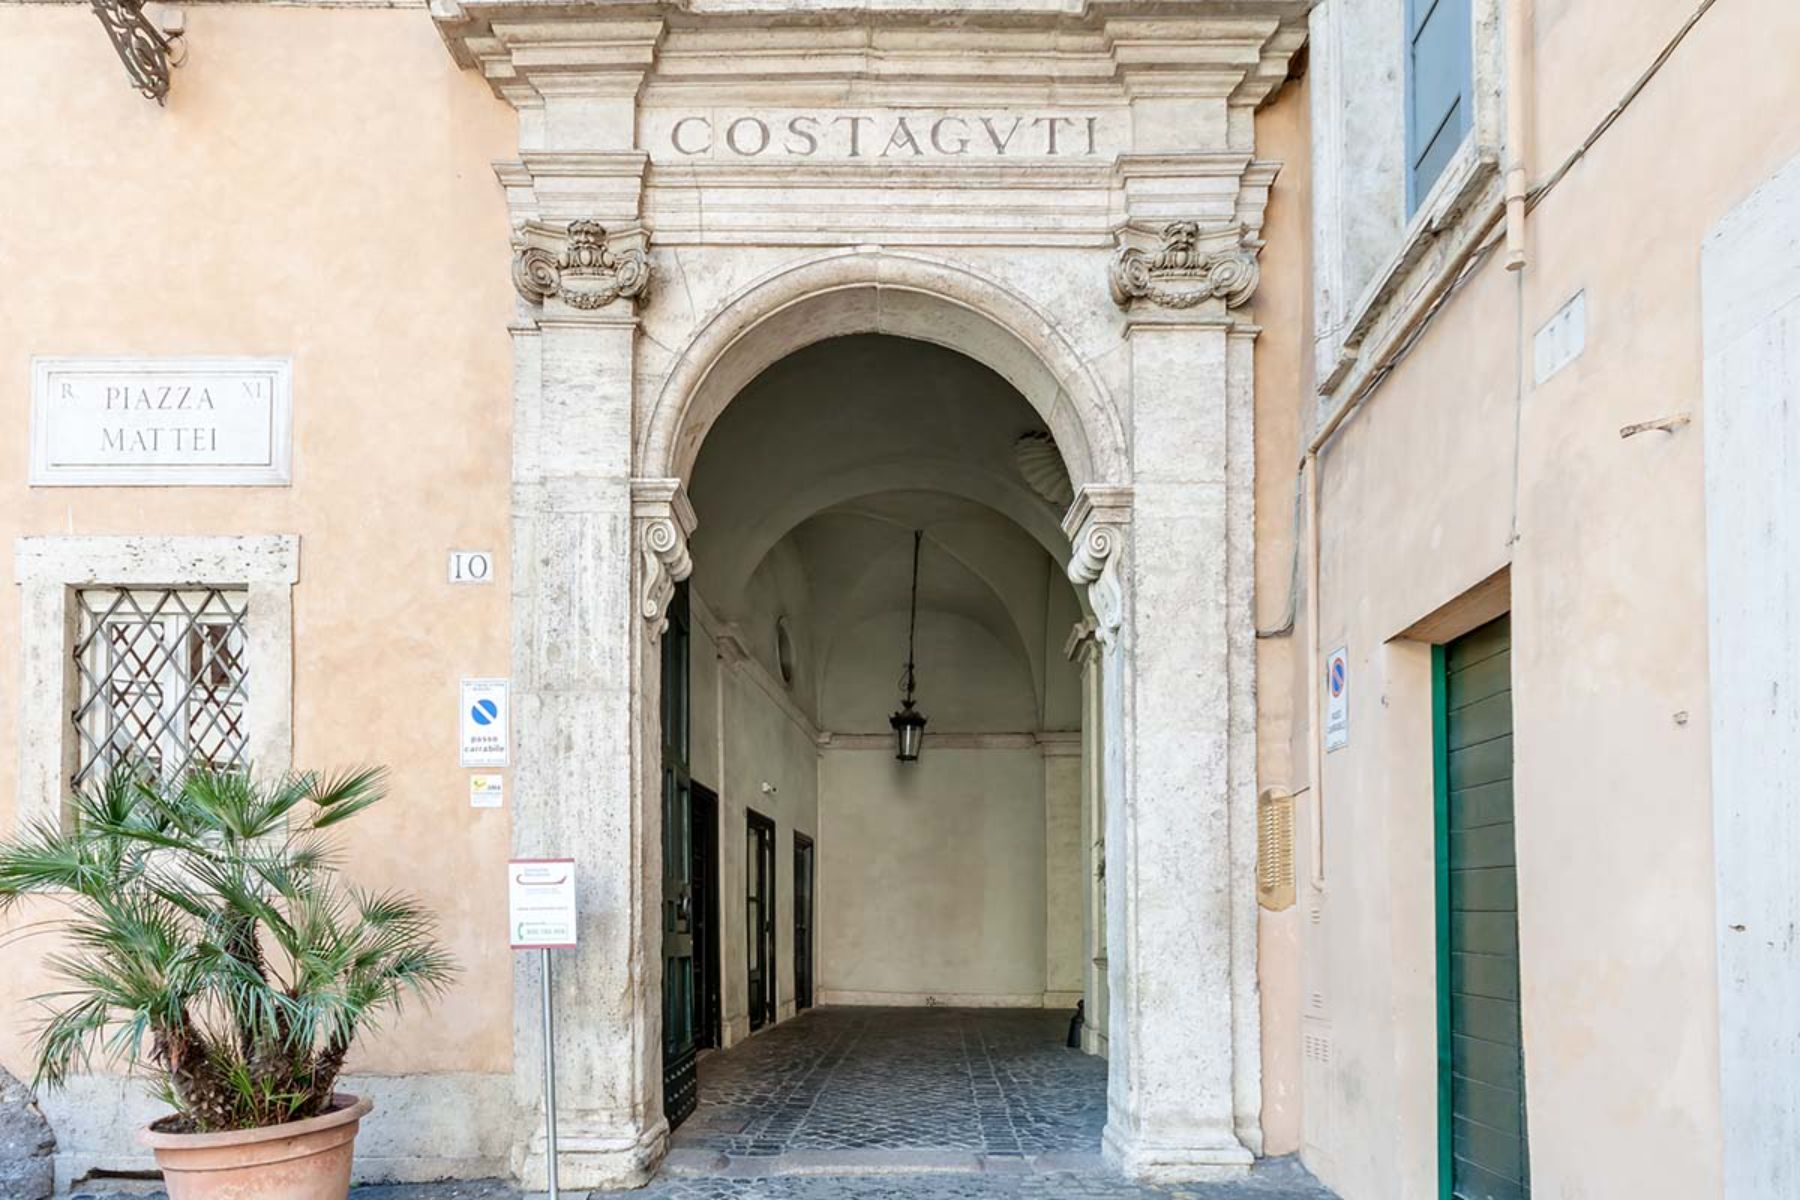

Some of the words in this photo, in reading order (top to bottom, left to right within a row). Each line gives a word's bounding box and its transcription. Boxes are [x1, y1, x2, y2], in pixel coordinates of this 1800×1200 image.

[670, 116, 1099, 158] COSTAGVTI
[106, 386, 215, 410] PIAZZA
[241, 381, 262, 399] XI
[101, 427, 217, 452] MATTEI
[455, 554, 488, 579] 10
[464, 744, 505, 753] carrabile
[470, 735, 499, 744] passo
